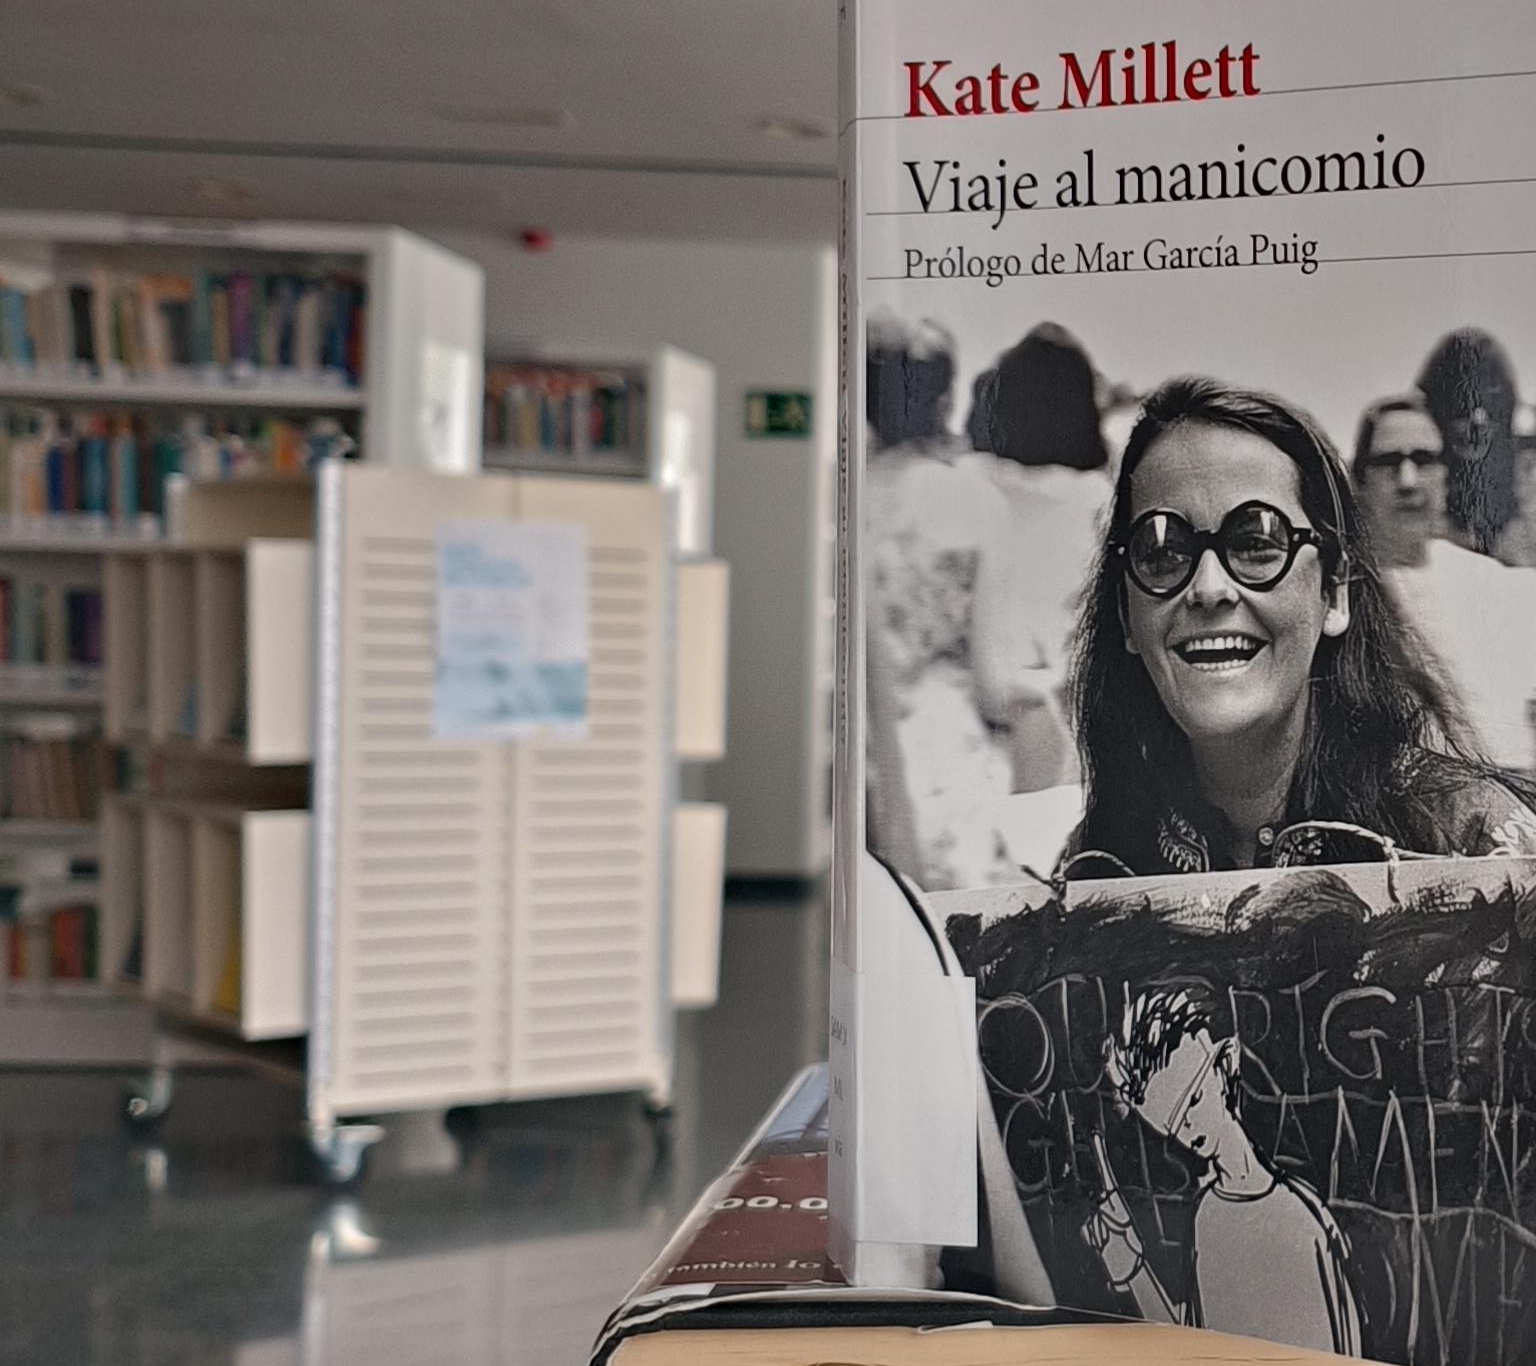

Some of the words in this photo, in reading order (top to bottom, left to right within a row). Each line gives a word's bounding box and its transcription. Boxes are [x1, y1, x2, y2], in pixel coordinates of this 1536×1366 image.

[903, 60, 1040, 118] Kate
[1057, 40, 1261, 110] Millett
[903, 159, 1039, 230] Viaje
[1055, 149, 1098, 209] al
[1115, 133, 1426, 205] manicomio
[903, 245, 1022, 288] Prólogo
[1031, 243, 1067, 275] de
[1075, 241, 1135, 274] Mar
[1143, 235, 1241, 271] García
[1250, 232, 1320, 275] Puig
